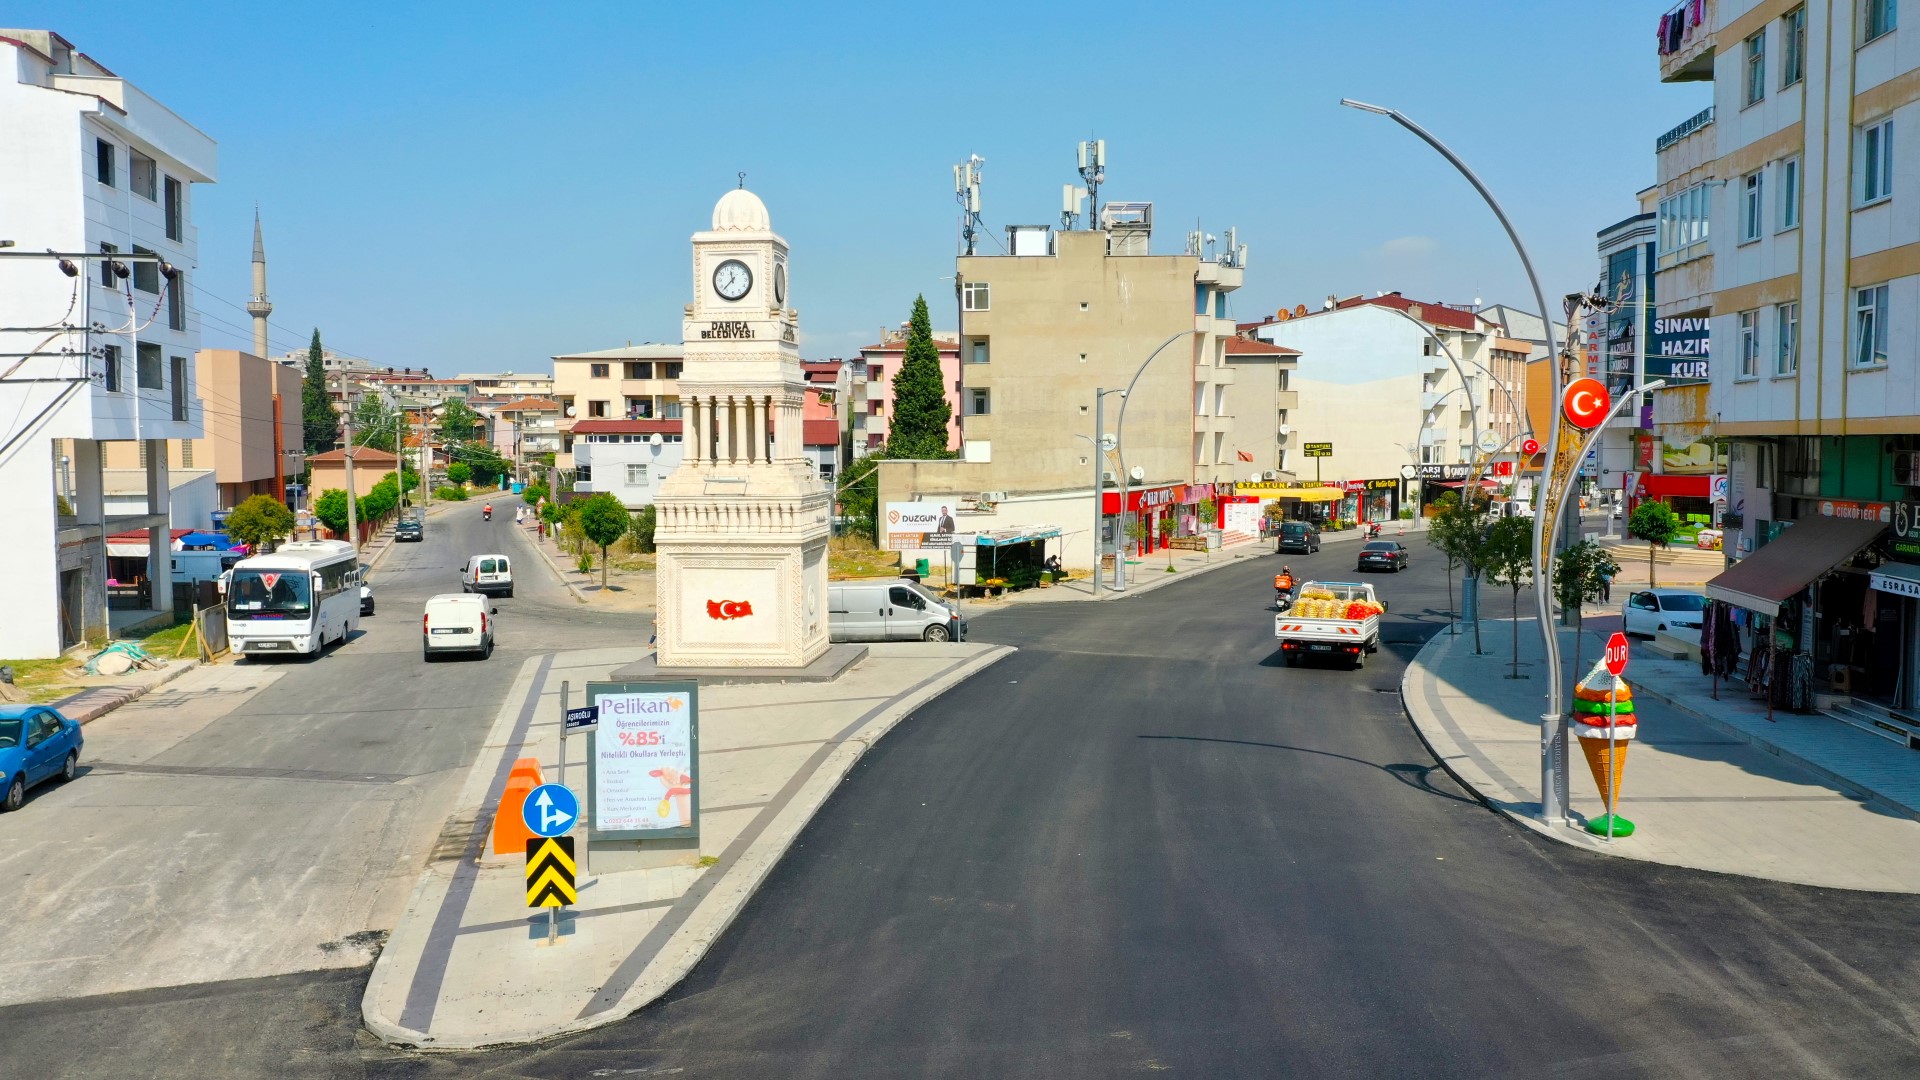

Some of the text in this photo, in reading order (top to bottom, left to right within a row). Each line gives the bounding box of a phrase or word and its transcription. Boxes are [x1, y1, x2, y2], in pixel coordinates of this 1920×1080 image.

[1671, 362, 1709, 378] KUR
[1883, 580, 1905, 592] ESRA
[1608, 645, 1626, 663] DUR
[602, 698, 670, 714] Pelikan
[616, 719, 670, 729] Öğrencilerimizin
[630, 750, 658, 758] Okullara
